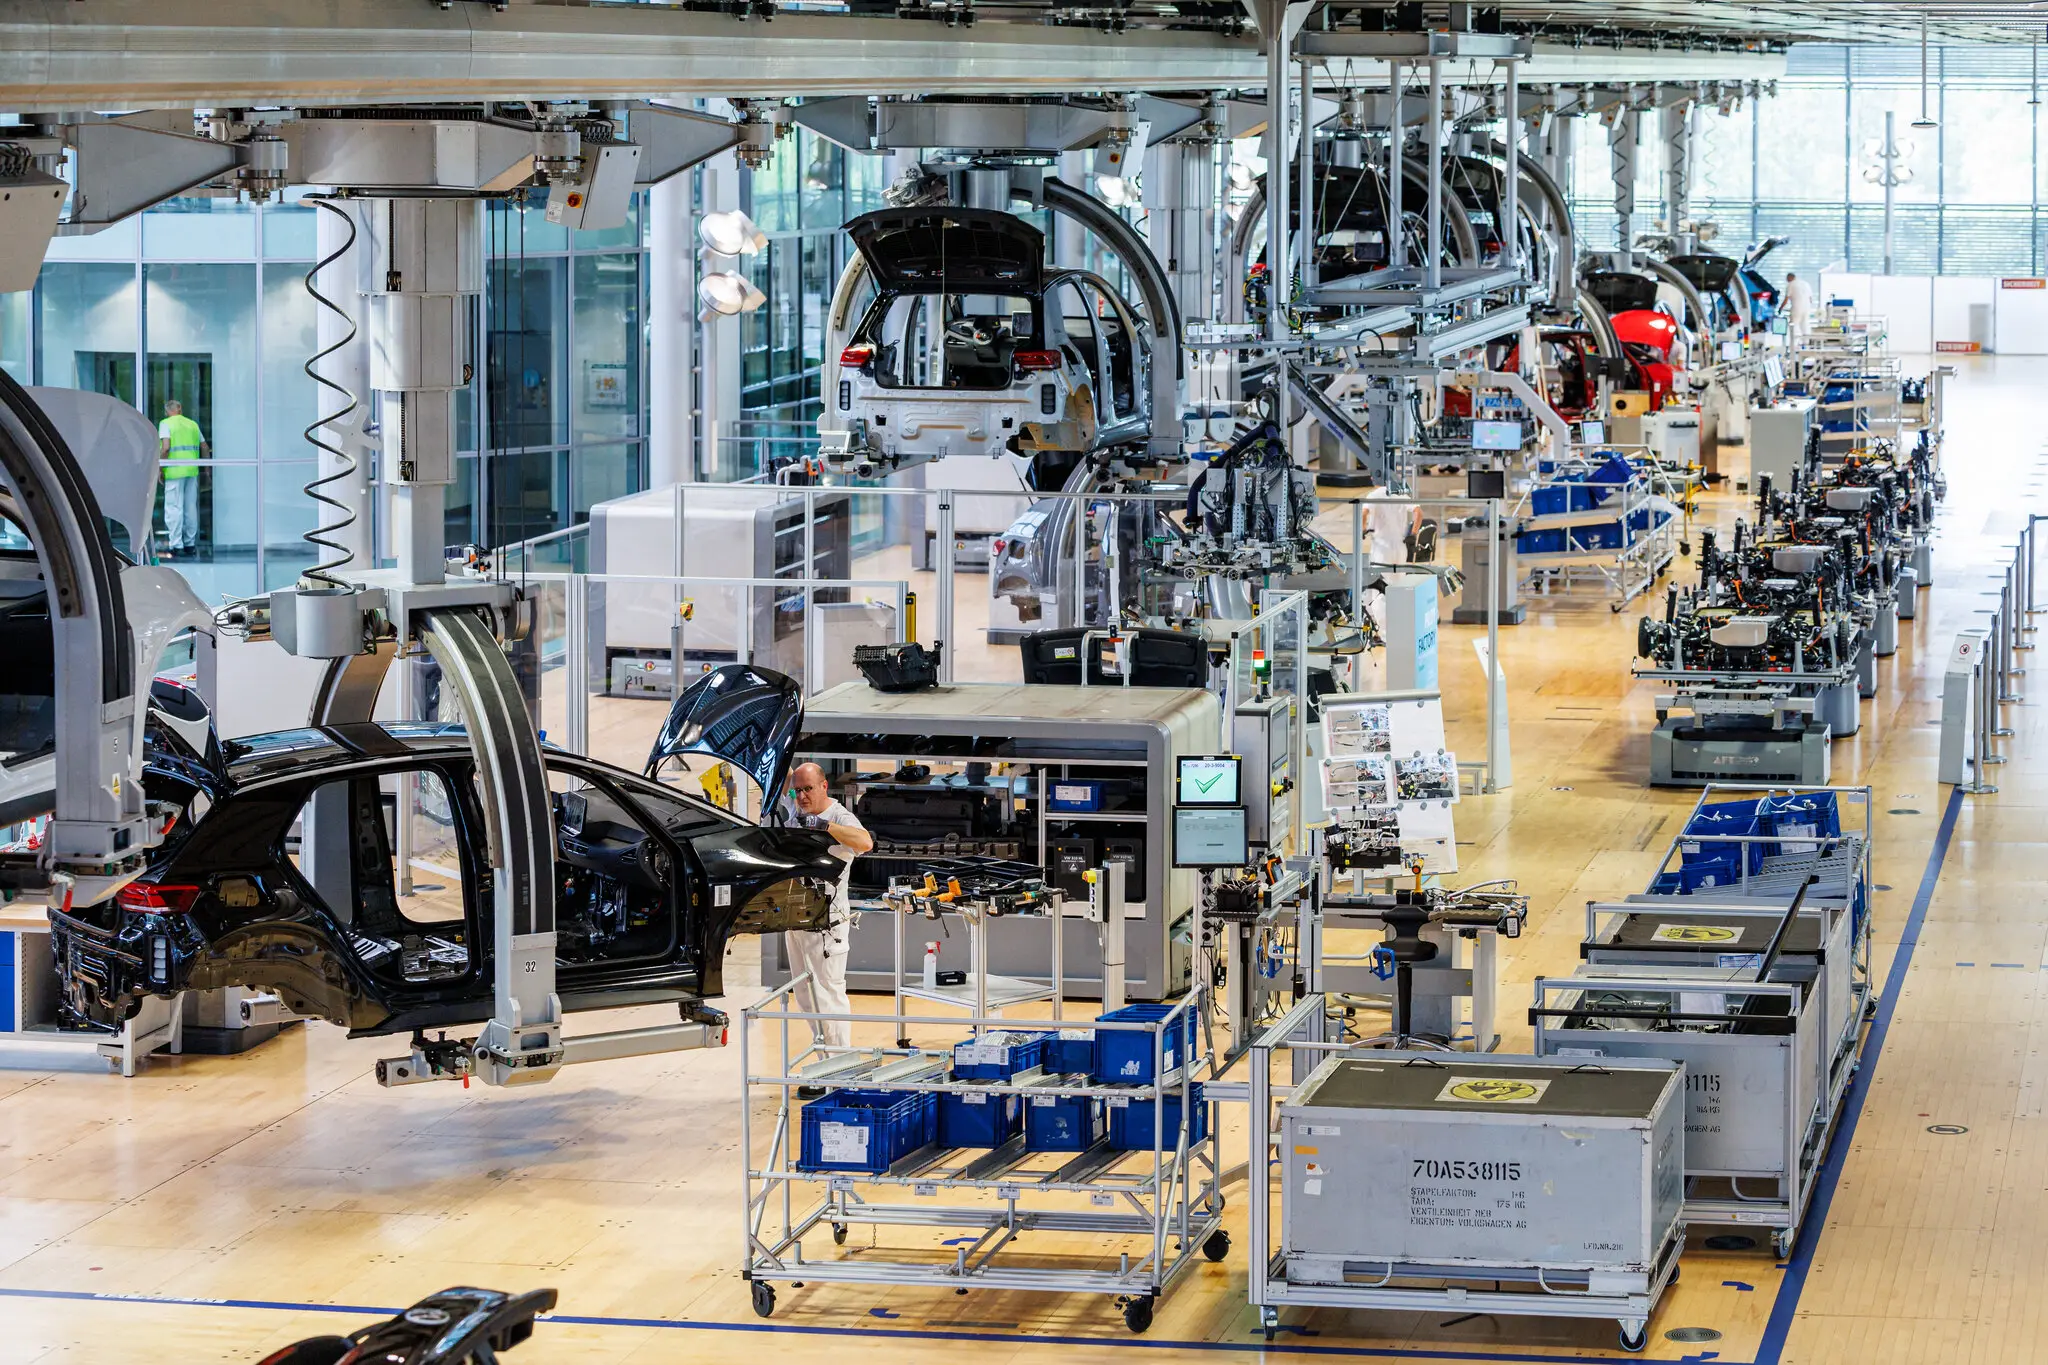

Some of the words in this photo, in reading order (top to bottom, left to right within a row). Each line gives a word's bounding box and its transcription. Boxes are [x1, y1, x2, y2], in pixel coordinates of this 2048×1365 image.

[626, 674, 644, 686] 211
[525, 960, 536, 973] 32
[1709, 1125, 1721, 1133] AG
[1413, 1159, 1521, 1181] 70A538115
[1496, 1199, 1511, 1209] 175
[1514, 1200, 1526, 1209] KG
[1458, 1218, 1512, 1229] VOLKSWAGEN
[1515, 1220, 1527, 1229] AG
